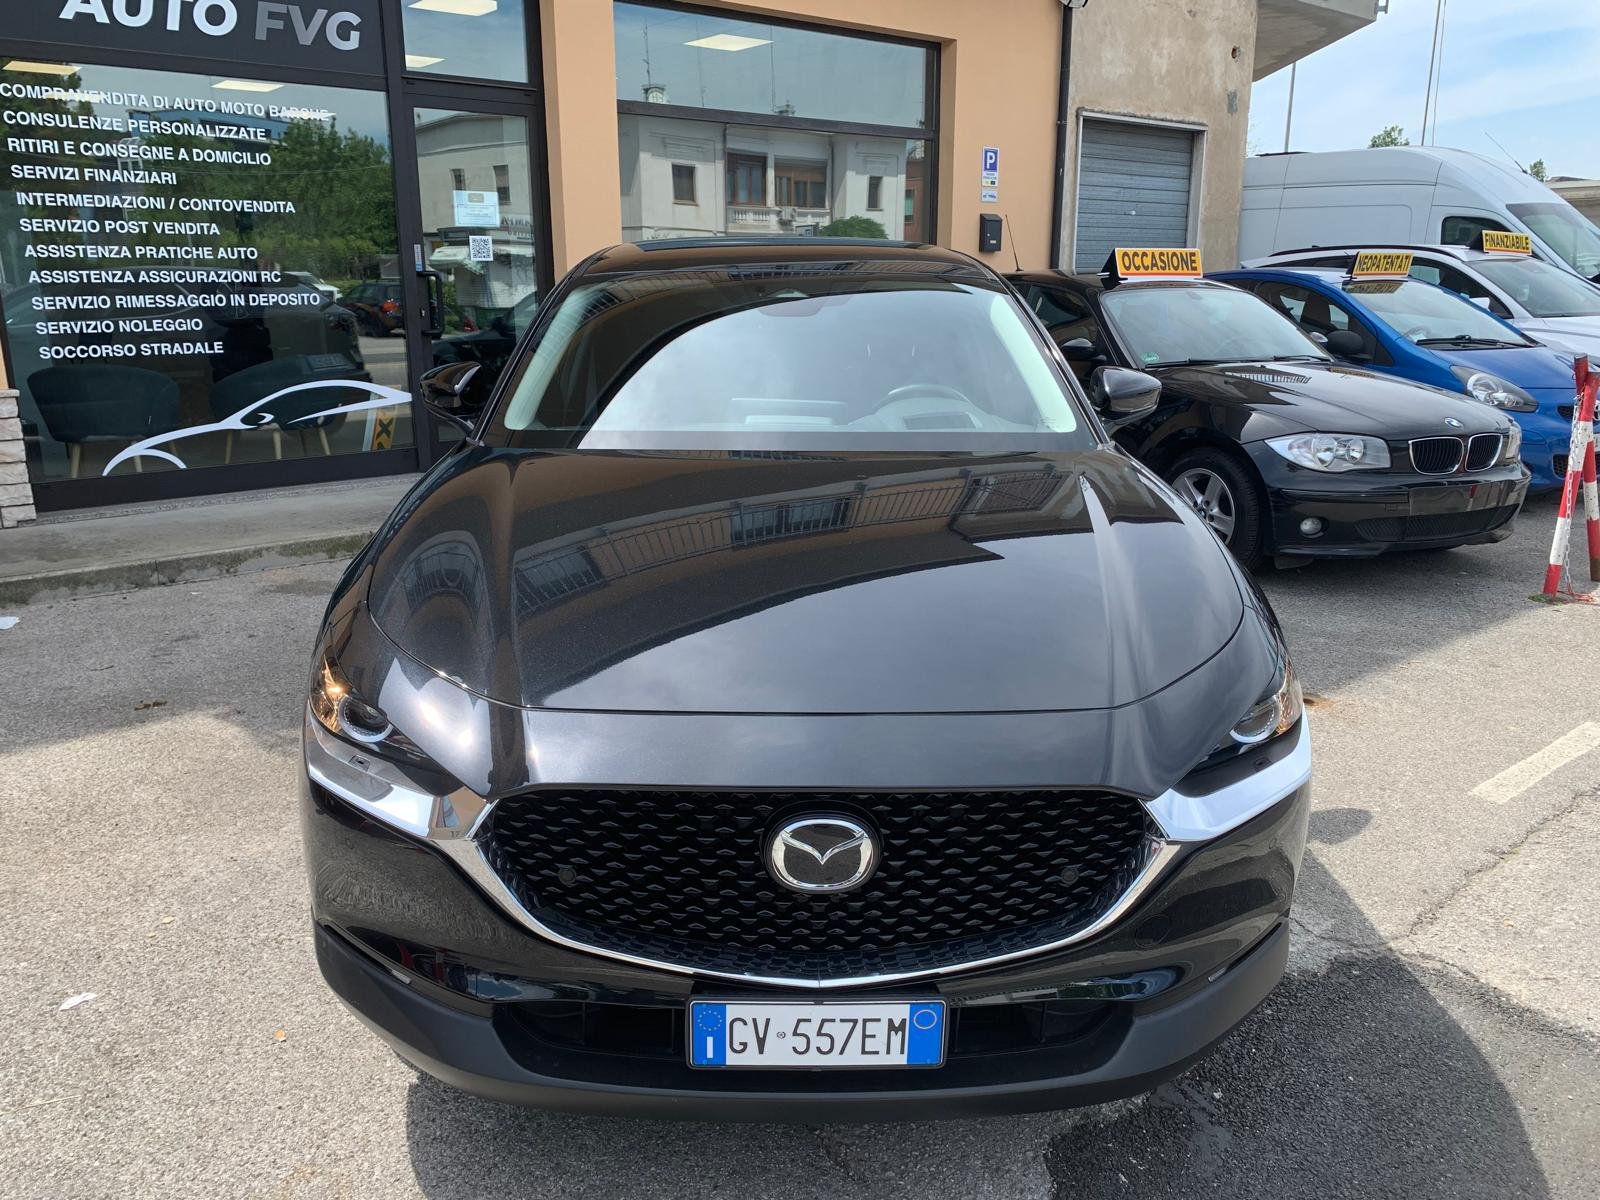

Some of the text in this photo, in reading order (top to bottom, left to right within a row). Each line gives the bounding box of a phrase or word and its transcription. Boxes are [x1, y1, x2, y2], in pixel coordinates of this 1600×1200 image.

[58, 0, 362, 51] AUTO FVG
[0, 82, 329, 121] COMPRAVENDITA DI AUTO MOTO BARCHE
[3, 110, 267, 141] CONSULENZE PERSONALIZZATE
[7, 137, 272, 166] RITIRI E CONSEGNE A DOMICILIO
[986, 151, 996, 169] P
[10, 164, 178, 185] SERVIZI FINANZIARI
[16, 191, 166, 210] INTERMEDIAZIONI
[178, 197, 296, 213] CONTOVENDITA
[19, 218, 221, 235] SERVIZIO POST VENDITA
[1484, 232, 1530, 251] FINANZIABILE
[24, 244, 258, 260] ASSISTENZA PRATICHE AUTO
[1121, 250, 1198, 272] OCCASIONE
[1354, 254, 1412, 273] NEOPATENTATI
[29, 270, 281, 283] ASSISTENZA ASSICURAZIONI RC
[31, 292, 320, 310] SERVIZIO RIMESSAGGIO IN DEPOSITO
[36, 318, 203, 335] SERVIZIO NOLEGGIO
[39, 341, 224, 359] SOCCORSO STRADALE
